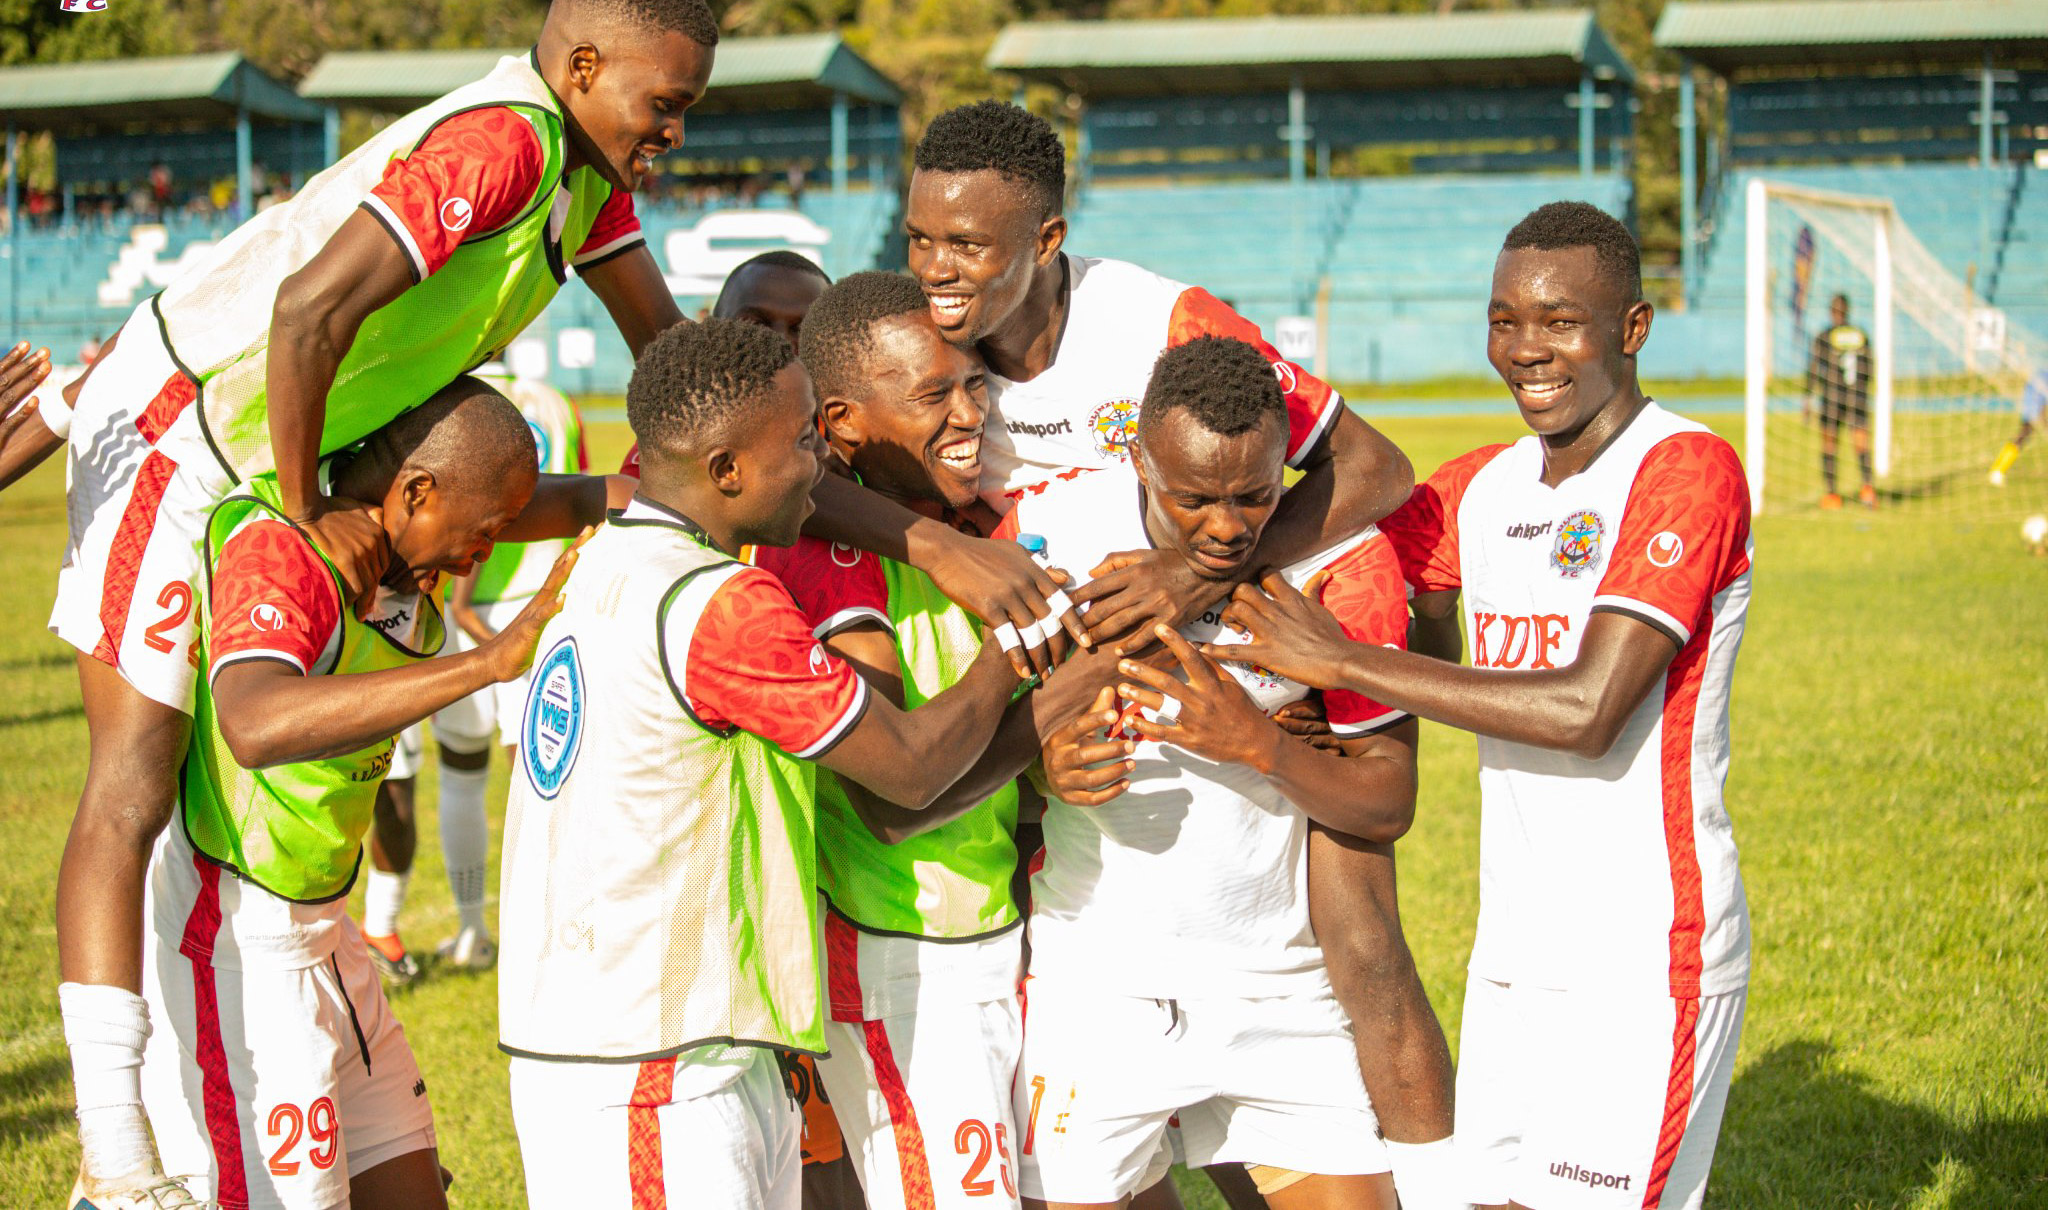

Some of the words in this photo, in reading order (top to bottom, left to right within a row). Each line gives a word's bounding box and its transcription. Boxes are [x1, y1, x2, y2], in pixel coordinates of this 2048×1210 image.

[1088, 401, 1115, 427] ULINZI
[1119, 399, 1142, 409] STA
[1557, 511, 1587, 532] ULINZI
[1473, 612, 1570, 669] KDF
[541, 698, 570, 737] WWS
[267, 1096, 339, 1176] 29
[954, 1118, 1017, 1200] 25
[1549, 1161, 1631, 1191] uhlsport
